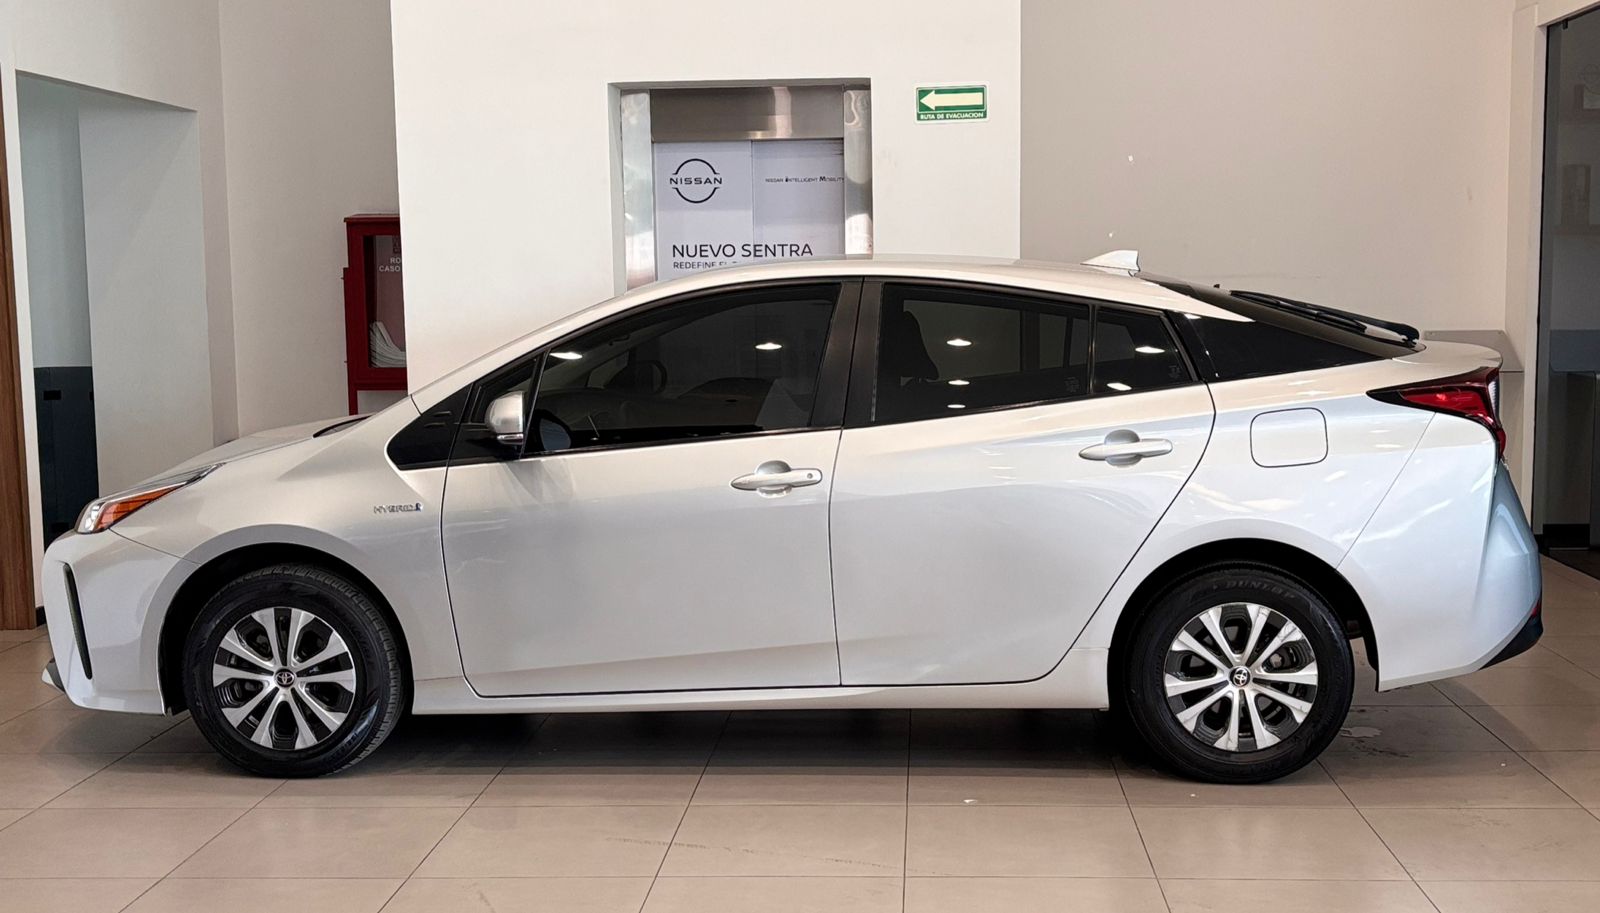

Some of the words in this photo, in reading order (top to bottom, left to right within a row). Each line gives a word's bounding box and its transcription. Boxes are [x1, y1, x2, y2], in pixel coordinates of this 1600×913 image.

[669, 177, 722, 185] NISSAN
[672, 243, 736, 258] NUEVO
[741, 243, 813, 258] SENTRA
